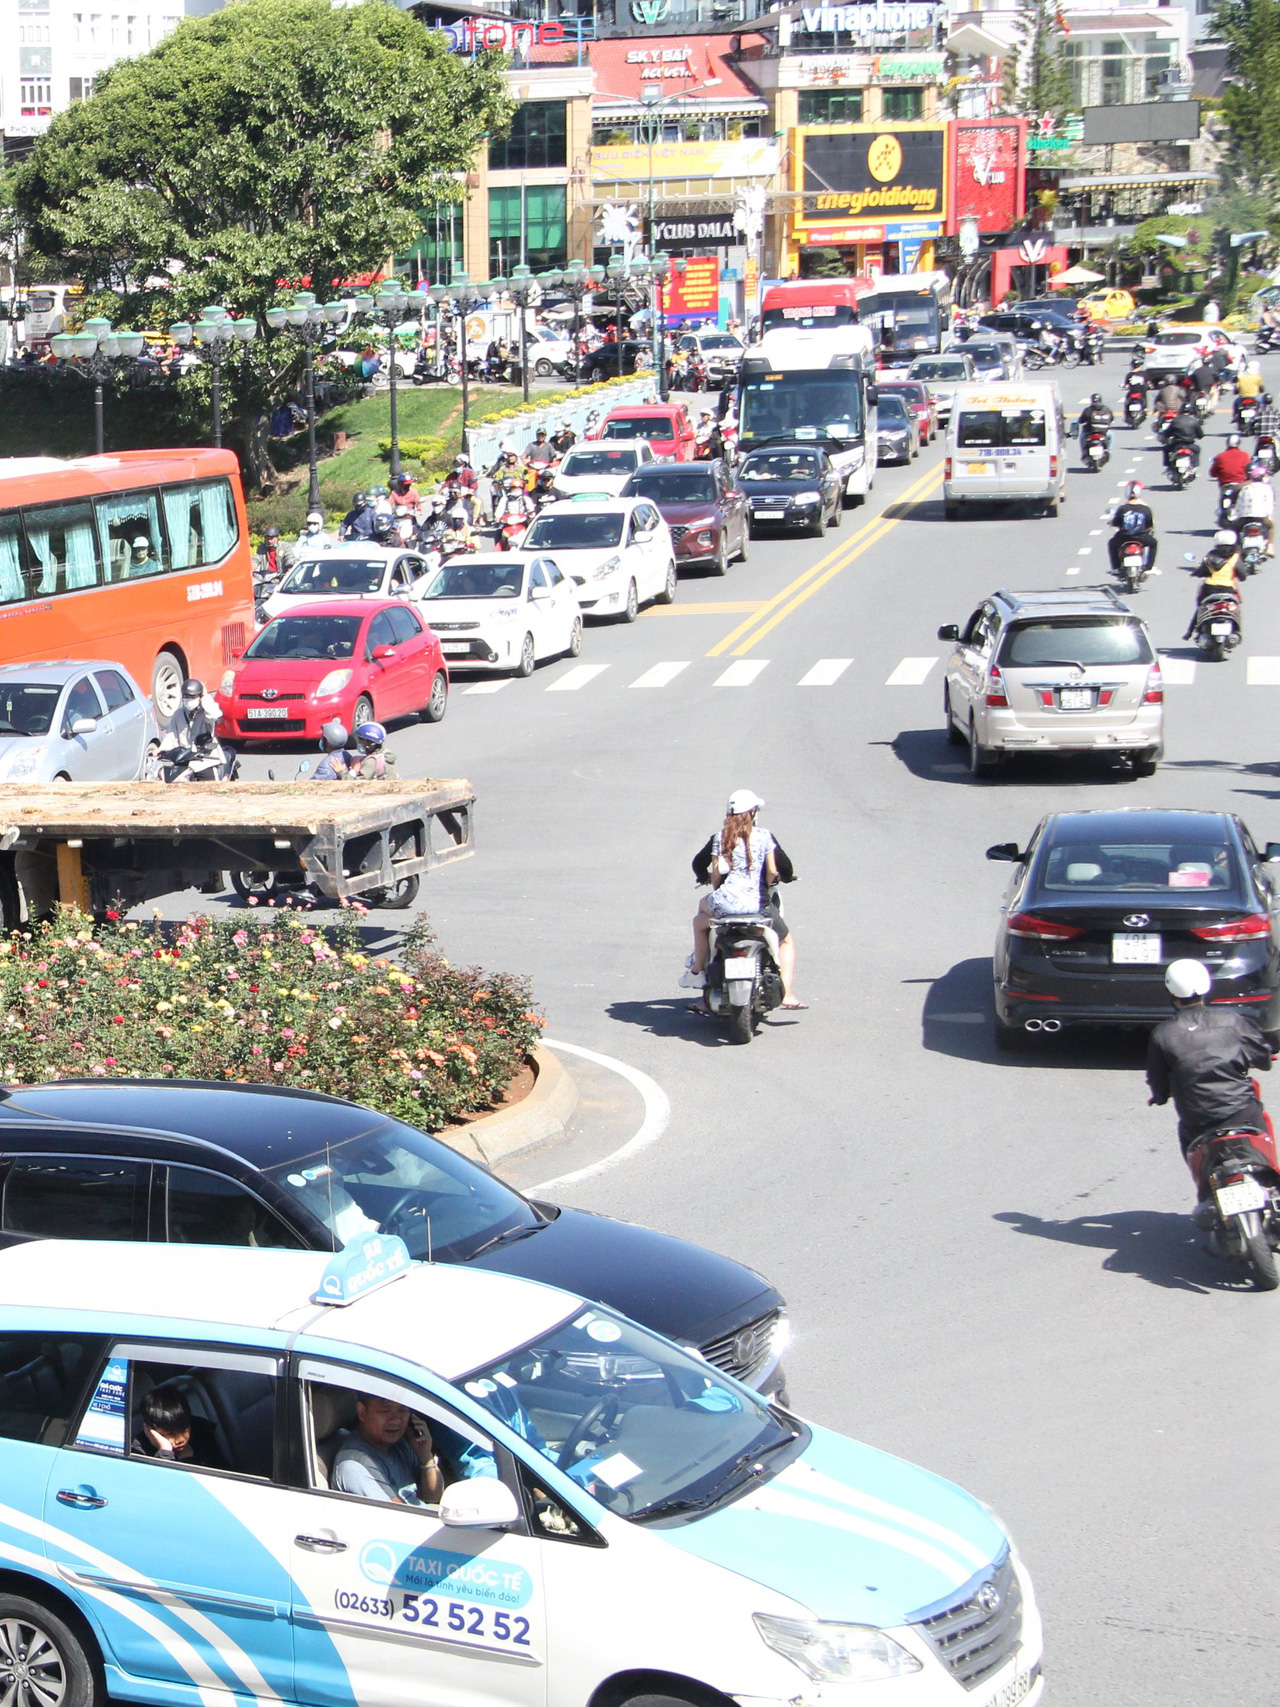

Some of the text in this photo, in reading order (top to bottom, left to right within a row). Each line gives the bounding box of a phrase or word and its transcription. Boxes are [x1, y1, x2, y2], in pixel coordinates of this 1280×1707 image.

[803, 0, 930, 35] vinaphone
[627, 52, 661, 64] SKY
[1026, 136, 1070, 150] eineken
[407, 1556, 442, 1576] TAXI
[446, 1563, 499, 1588] QUỐC
[501, 1570, 523, 1591] TẾ
[425, 1577, 433, 1587] là
[456, 1586, 473, 1598] yêu
[334, 1588, 530, 1646] (02633) 52 52 52
